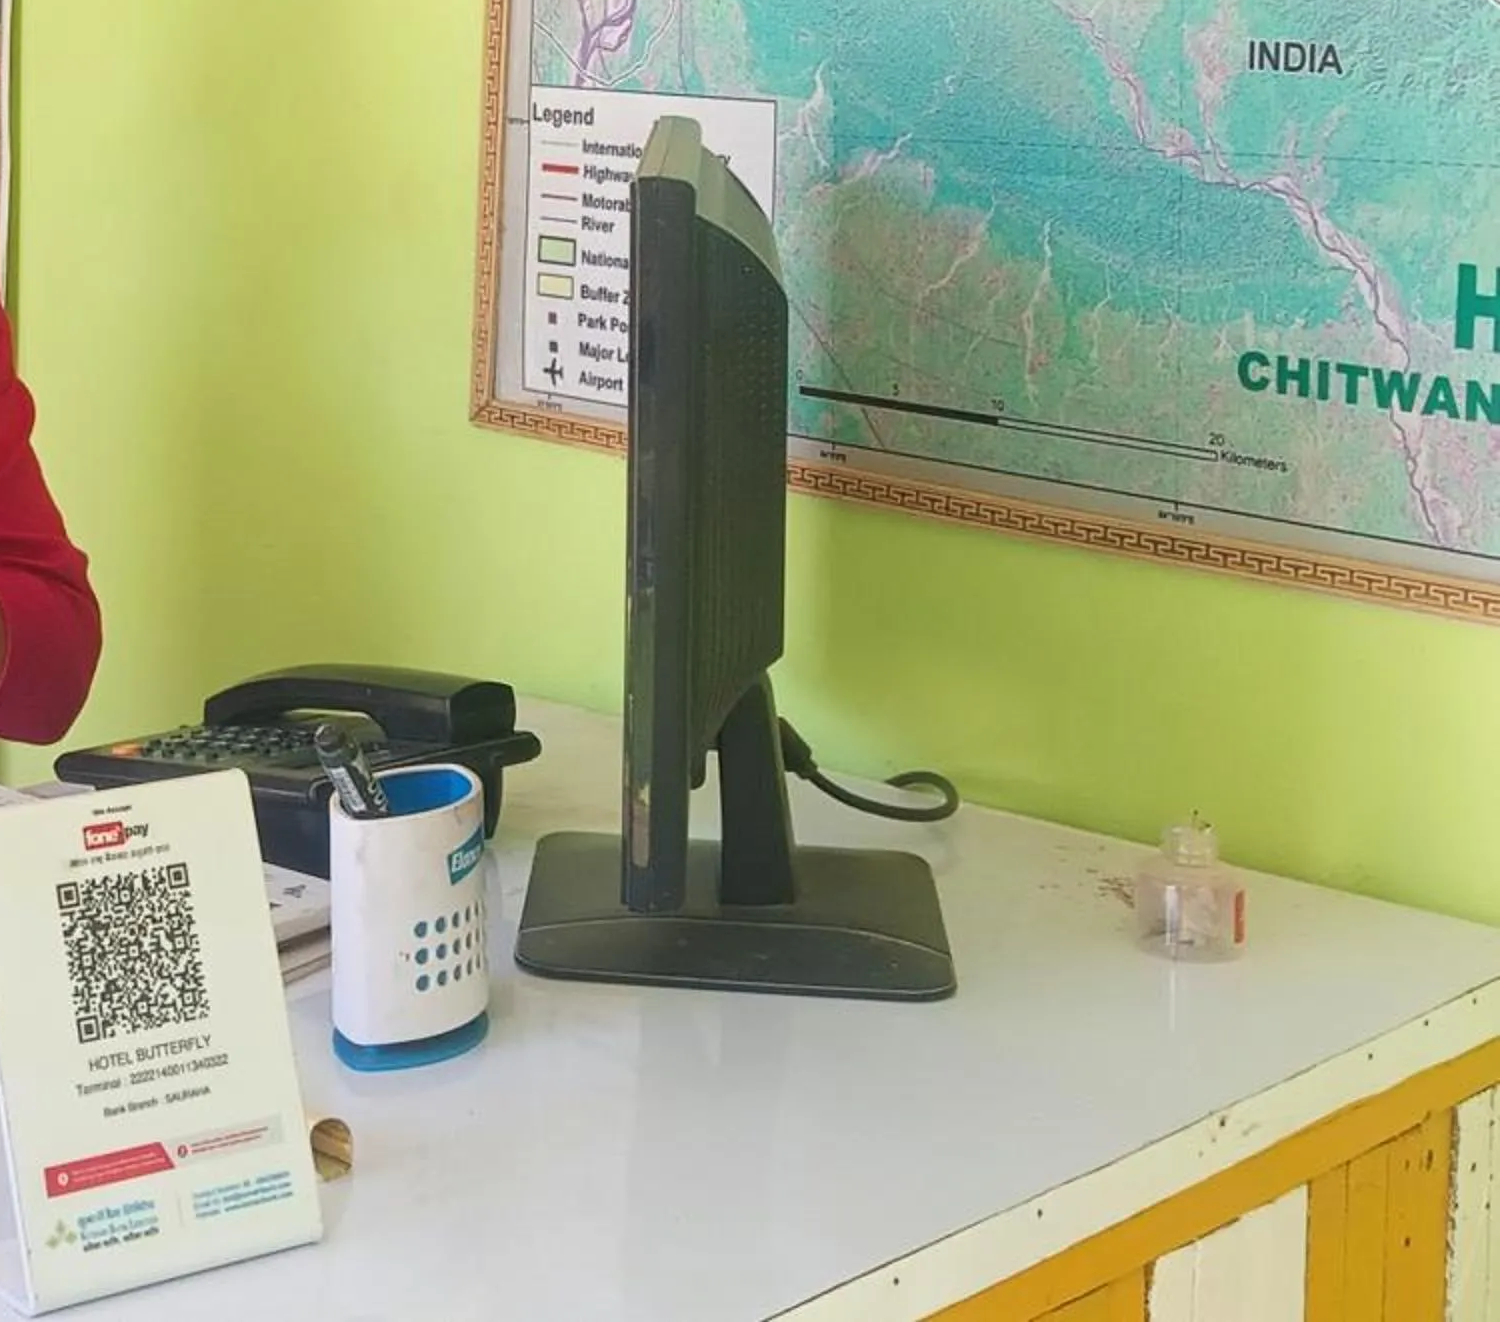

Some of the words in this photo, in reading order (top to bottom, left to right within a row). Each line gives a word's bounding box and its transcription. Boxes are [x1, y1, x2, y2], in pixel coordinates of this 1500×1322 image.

[1249, 40, 1343, 75] INDIA
[532, 102, 595, 128] Legend
[581, 215, 615, 233] River
[580, 284, 620, 304] Buffer
[1455, 262, 1500, 353] H
[578, 312, 607, 331] Park
[579, 341, 615, 362] Major
[579, 370, 624, 392] Airport
[1237, 350, 1500, 425] CHITWAN
[1208, 431, 1225, 447] 20
[1220, 449, 1288, 473] Kilometers
[88, 1051, 133, 1072] HOTEL
[135, 1033, 211, 1062] BUTTERFLY
